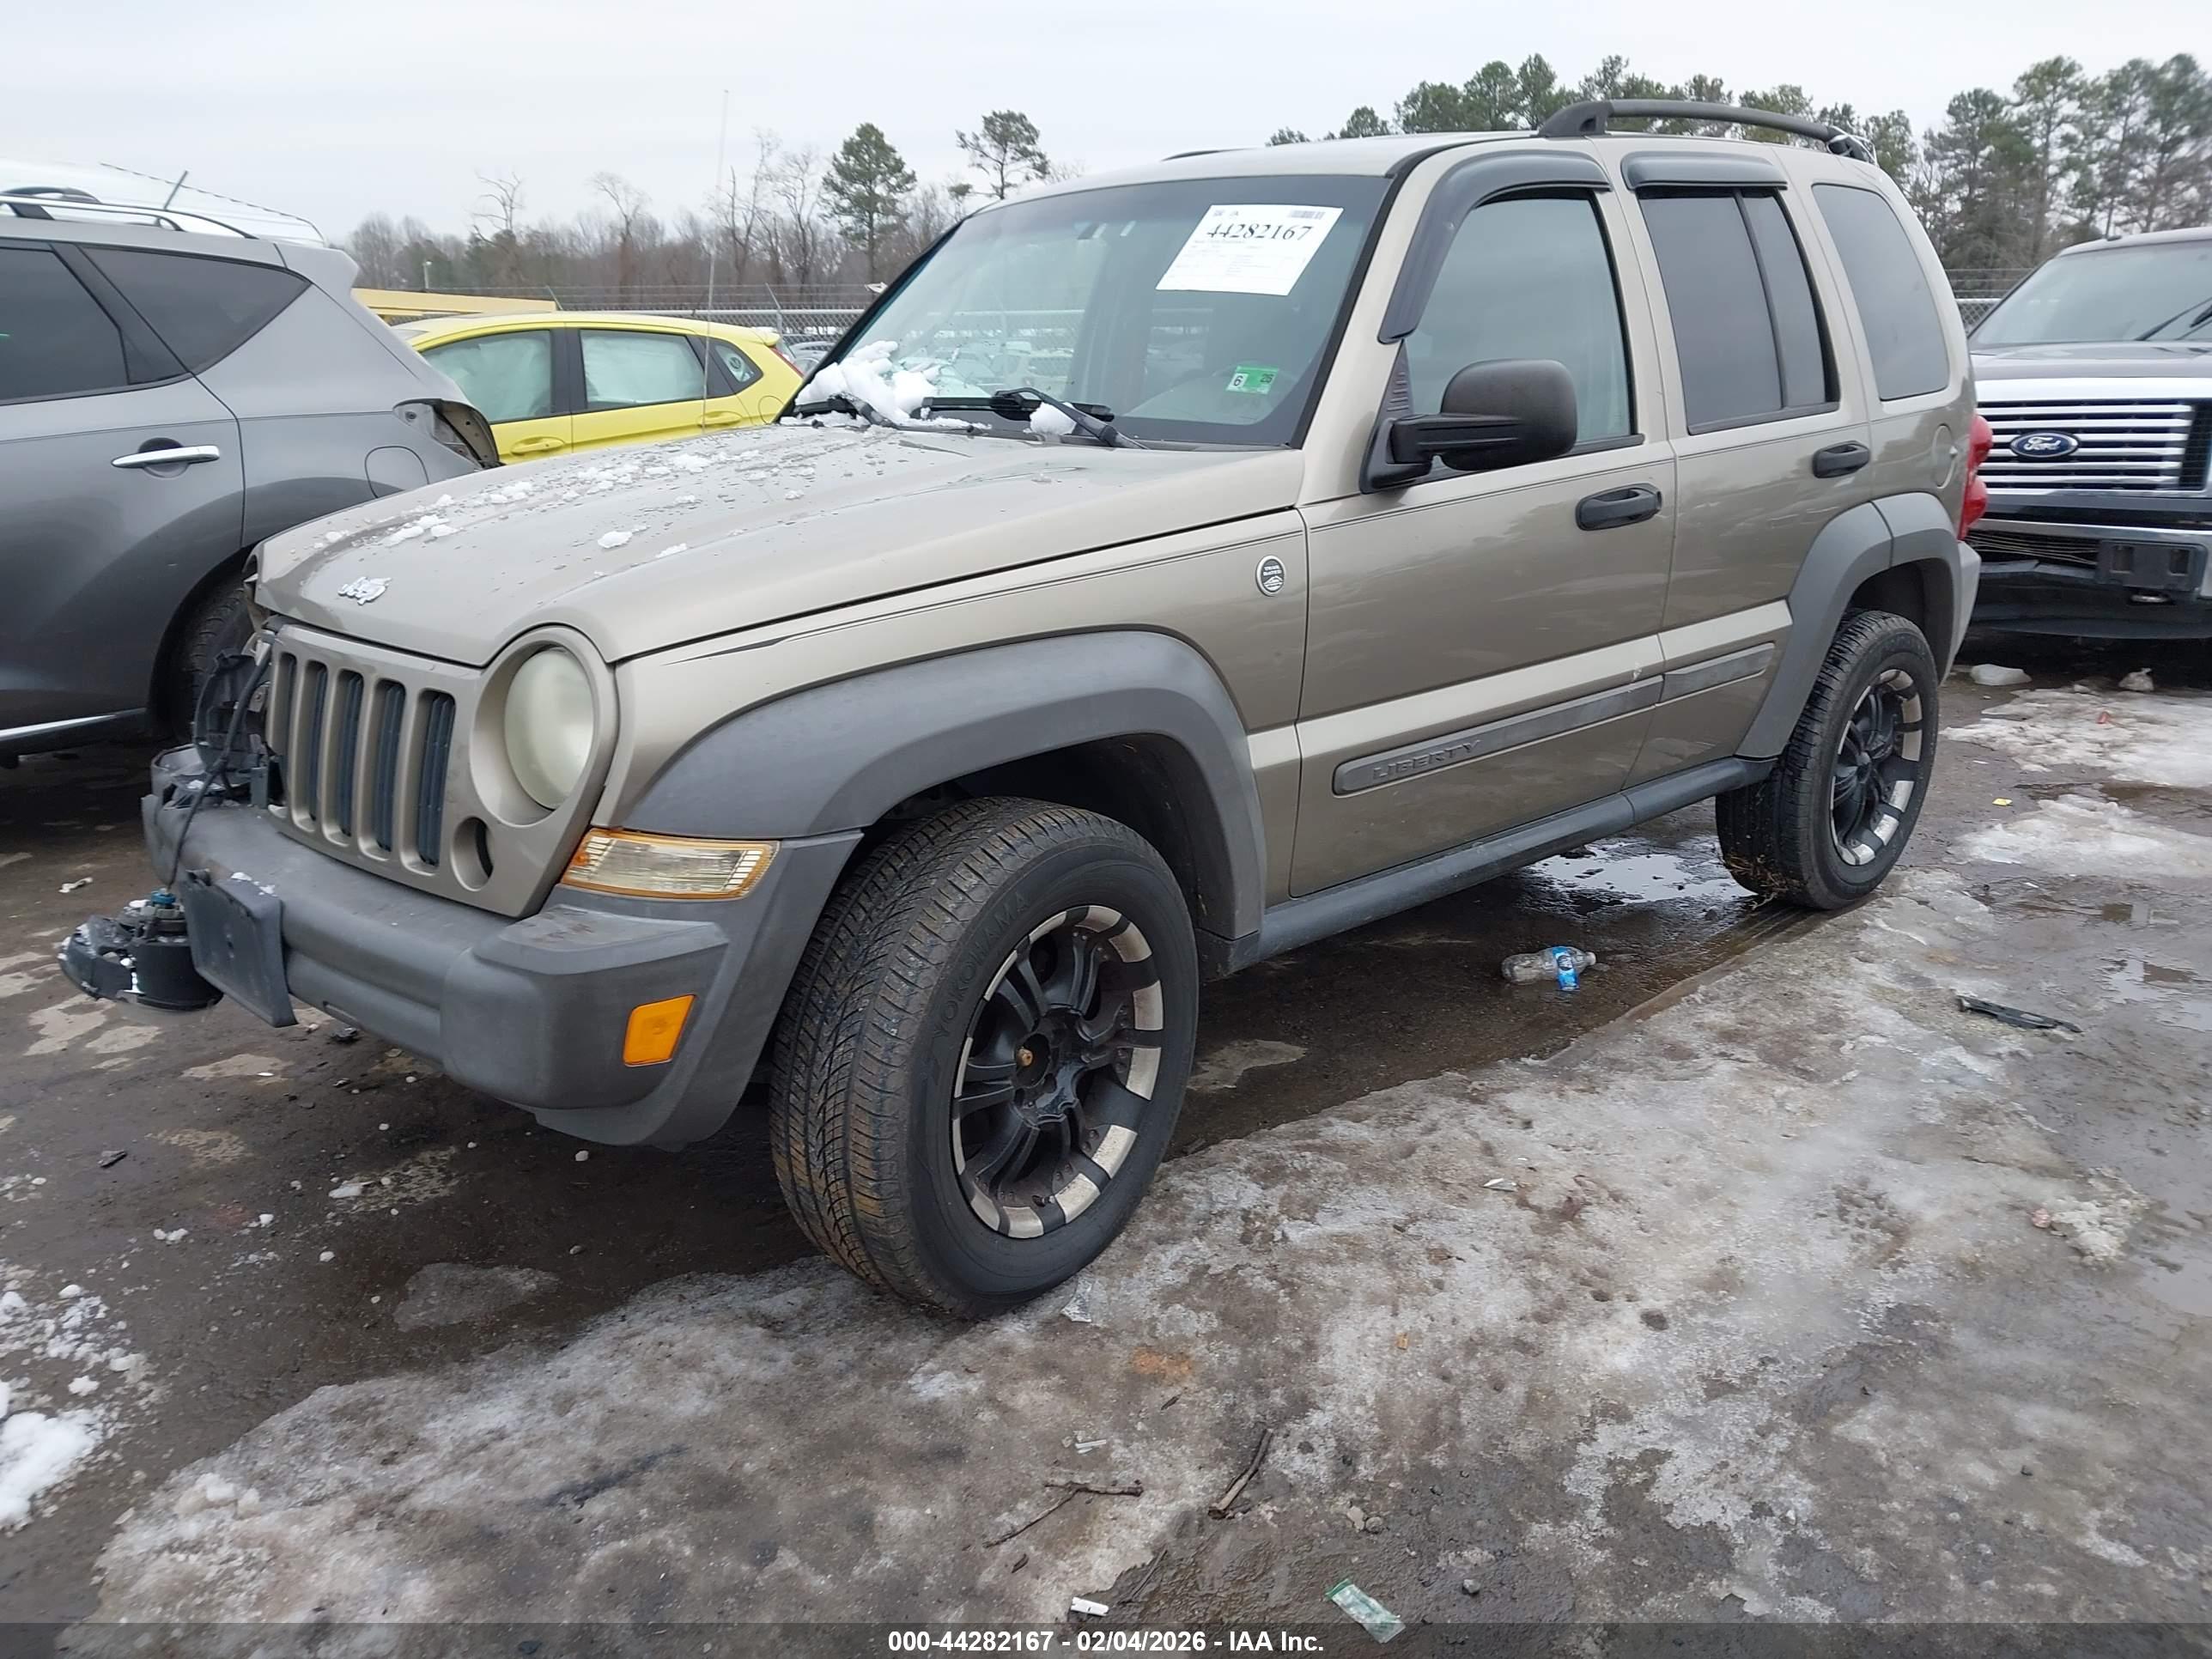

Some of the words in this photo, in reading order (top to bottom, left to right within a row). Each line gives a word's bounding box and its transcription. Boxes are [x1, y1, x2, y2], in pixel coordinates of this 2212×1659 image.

[1206, 223, 1314, 240] 44282167
[1233, 375, 1243, 386] 6
[2023, 436, 2062, 451] Ford
[1373, 739, 1480, 779] LIBERTY
[933, 890, 1030, 1038] YOKOHAMA
